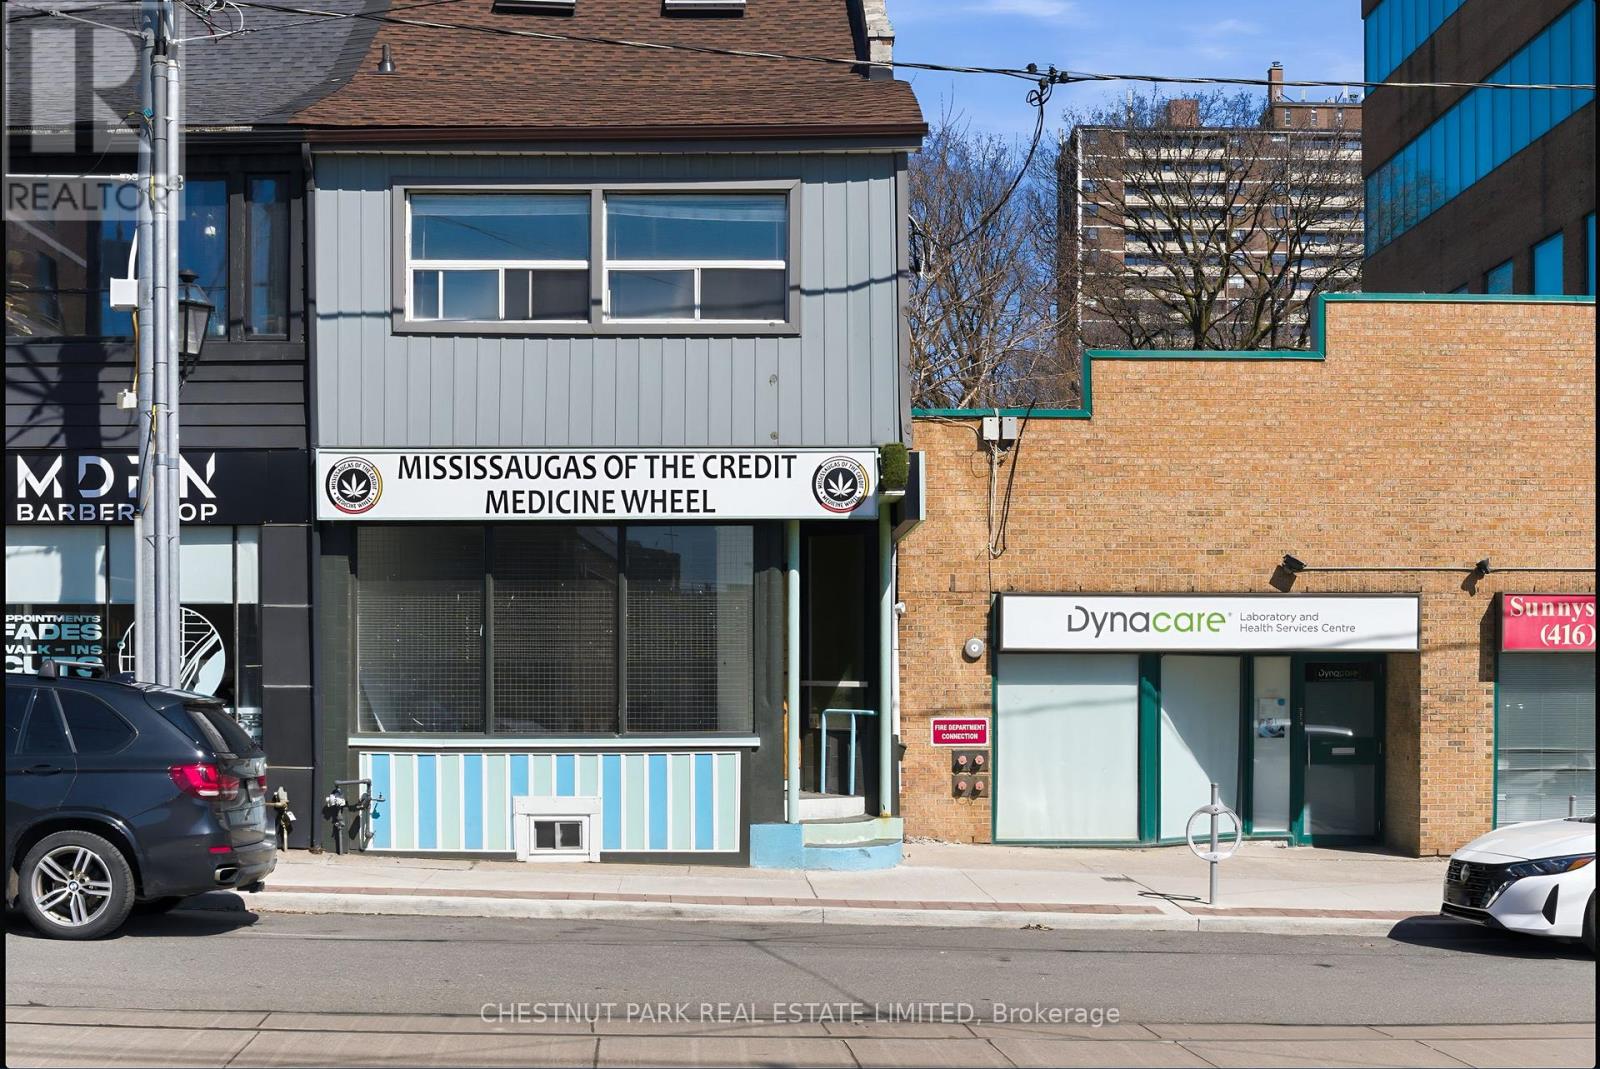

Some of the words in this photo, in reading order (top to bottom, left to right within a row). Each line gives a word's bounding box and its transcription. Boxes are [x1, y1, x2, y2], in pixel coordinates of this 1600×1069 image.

[397, 454, 597, 480] MISSISSAUGAS
[604, 454, 639, 480] OF
[646, 454, 696, 480] THE
[702, 454, 798, 480] CREDIT
[17, 502, 218, 521] BARBEROP
[485, 489, 616, 514] MEDICINE
[620, 489, 716, 514] WHEEL
[1240, 612, 1297, 623] Laboratory
[1299, 612, 1319, 622] and
[1510, 596, 1595, 623] Sunnys
[1067, 605, 1227, 639] Dynacare
[1240, 623, 1273, 633] Health
[1276, 623, 1319, 633] Services
[1321, 623, 1356, 633] Centre
[1540, 623, 1596, 647] (416)
[71, 645, 102, 654] INS
